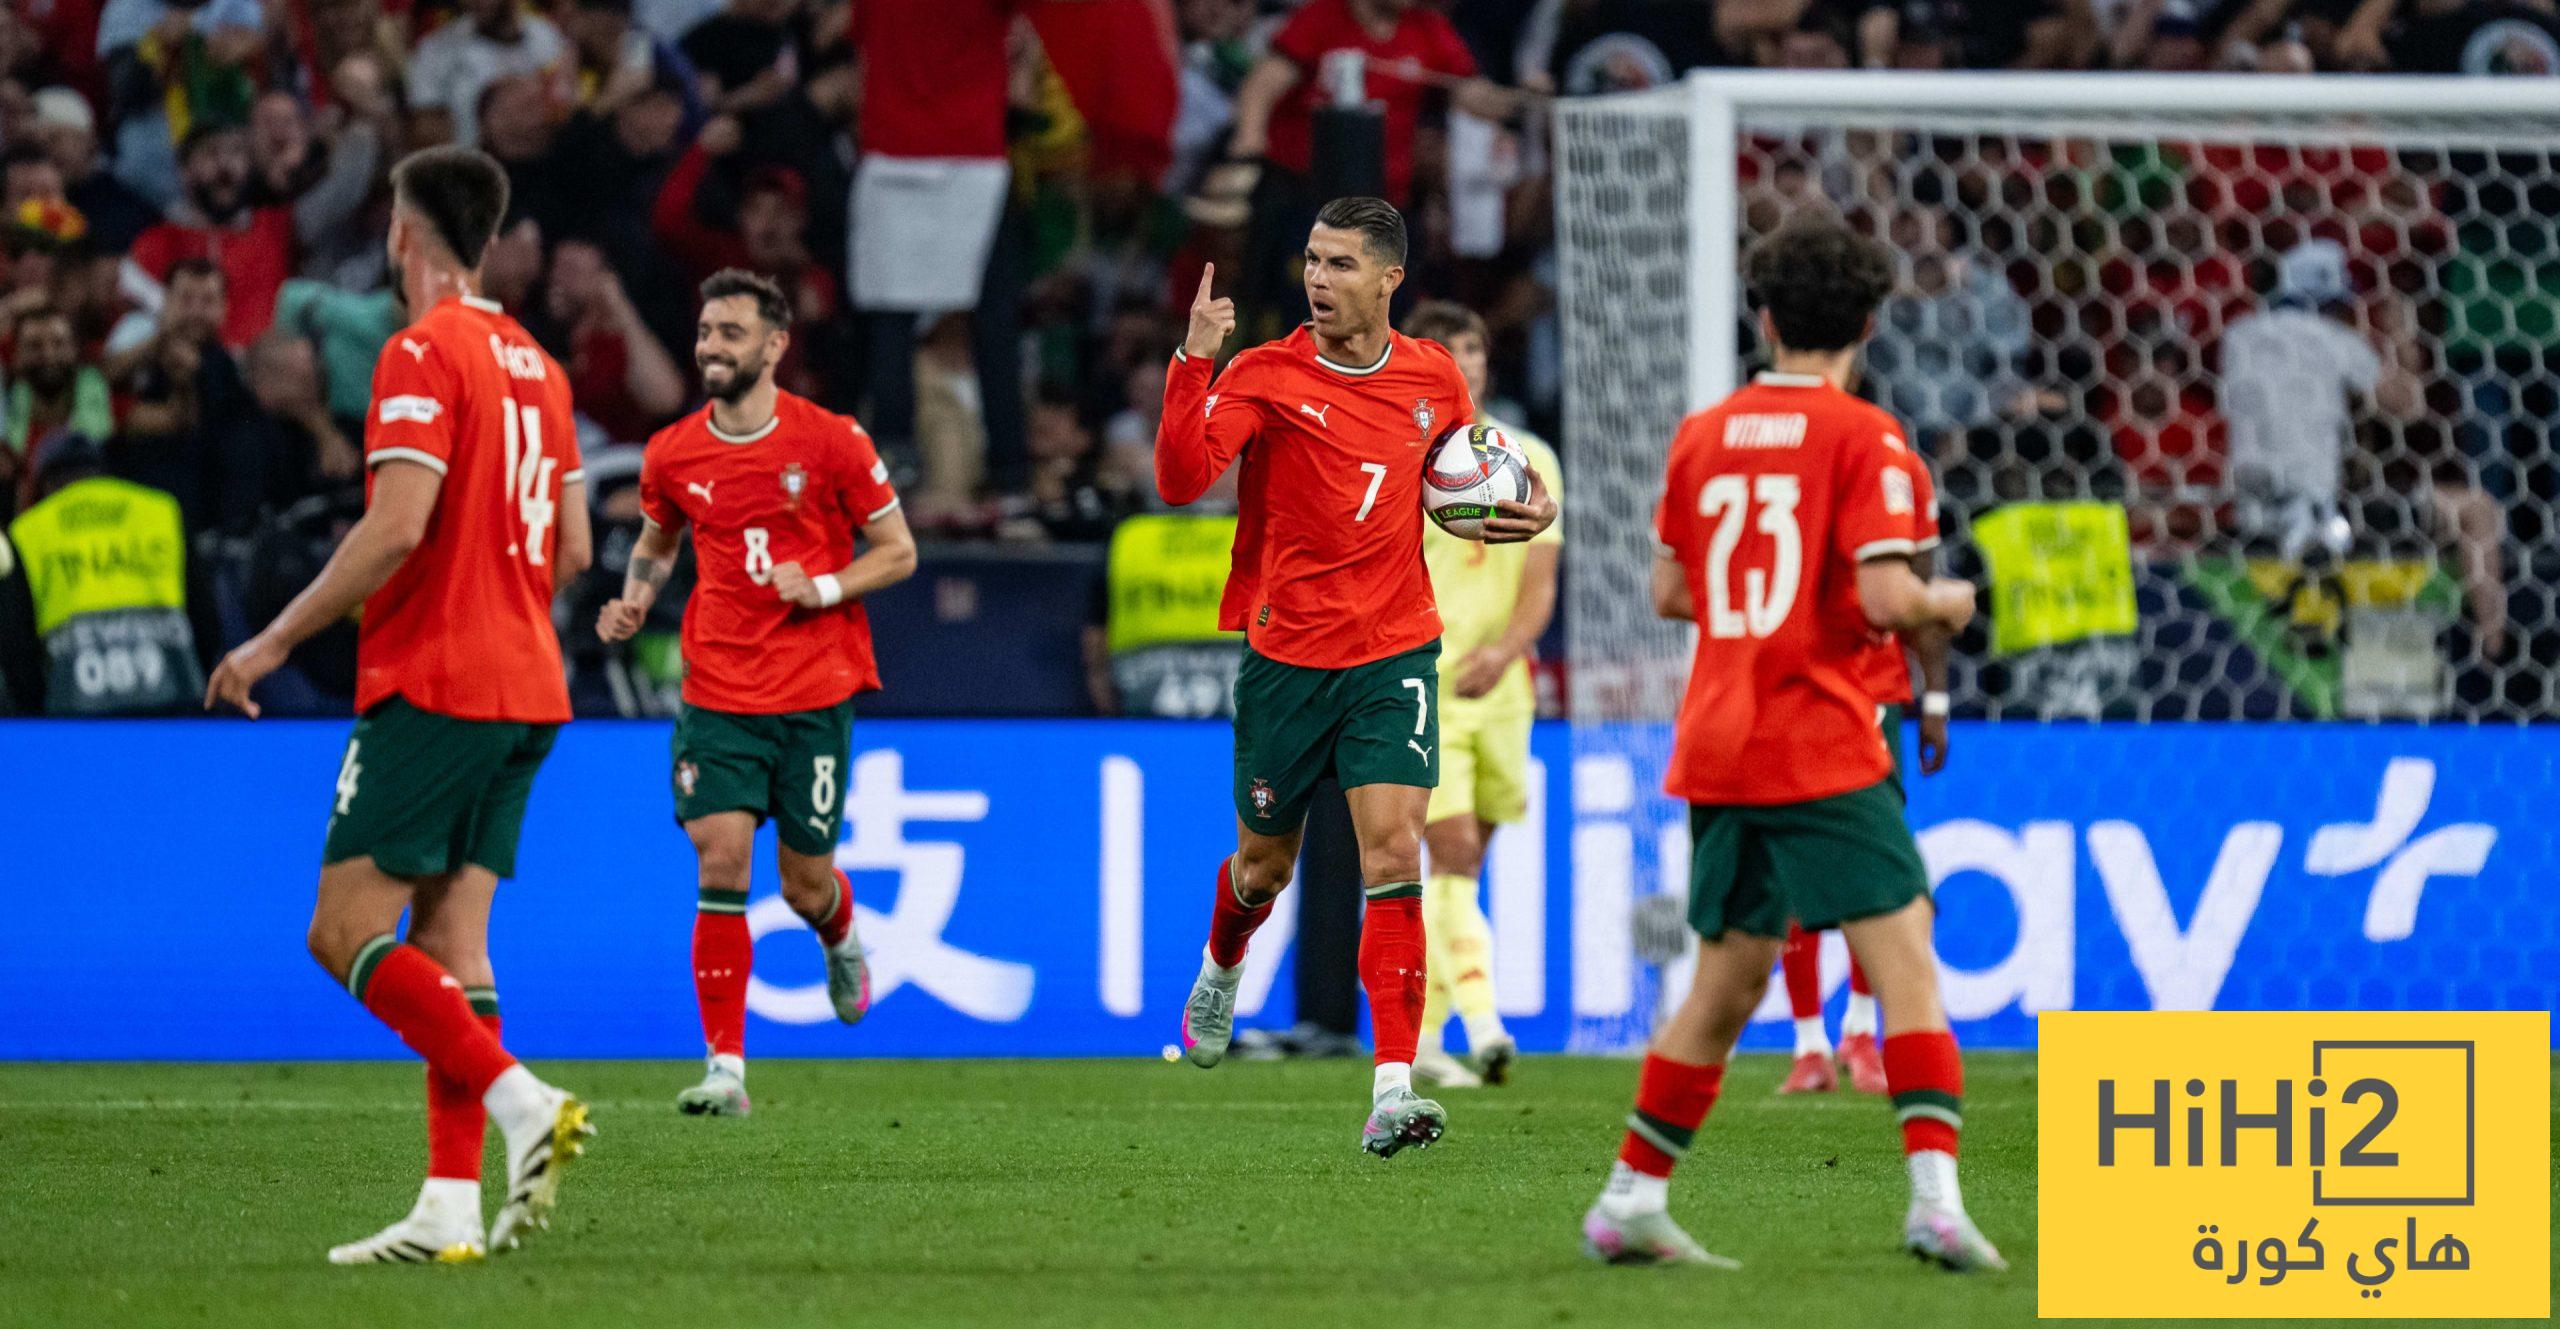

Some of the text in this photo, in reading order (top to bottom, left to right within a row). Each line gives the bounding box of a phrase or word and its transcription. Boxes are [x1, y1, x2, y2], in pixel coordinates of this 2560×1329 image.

[503, 397, 558, 565] 14
[1355, 462, 1388, 522] 7
[1442, 507, 1480, 519] LEAGUE
[744, 527, 773, 585] 8
[1698, 474, 1803, 639] 23
[1402, 678, 1428, 735] 7
[812, 755, 836, 815] 8
